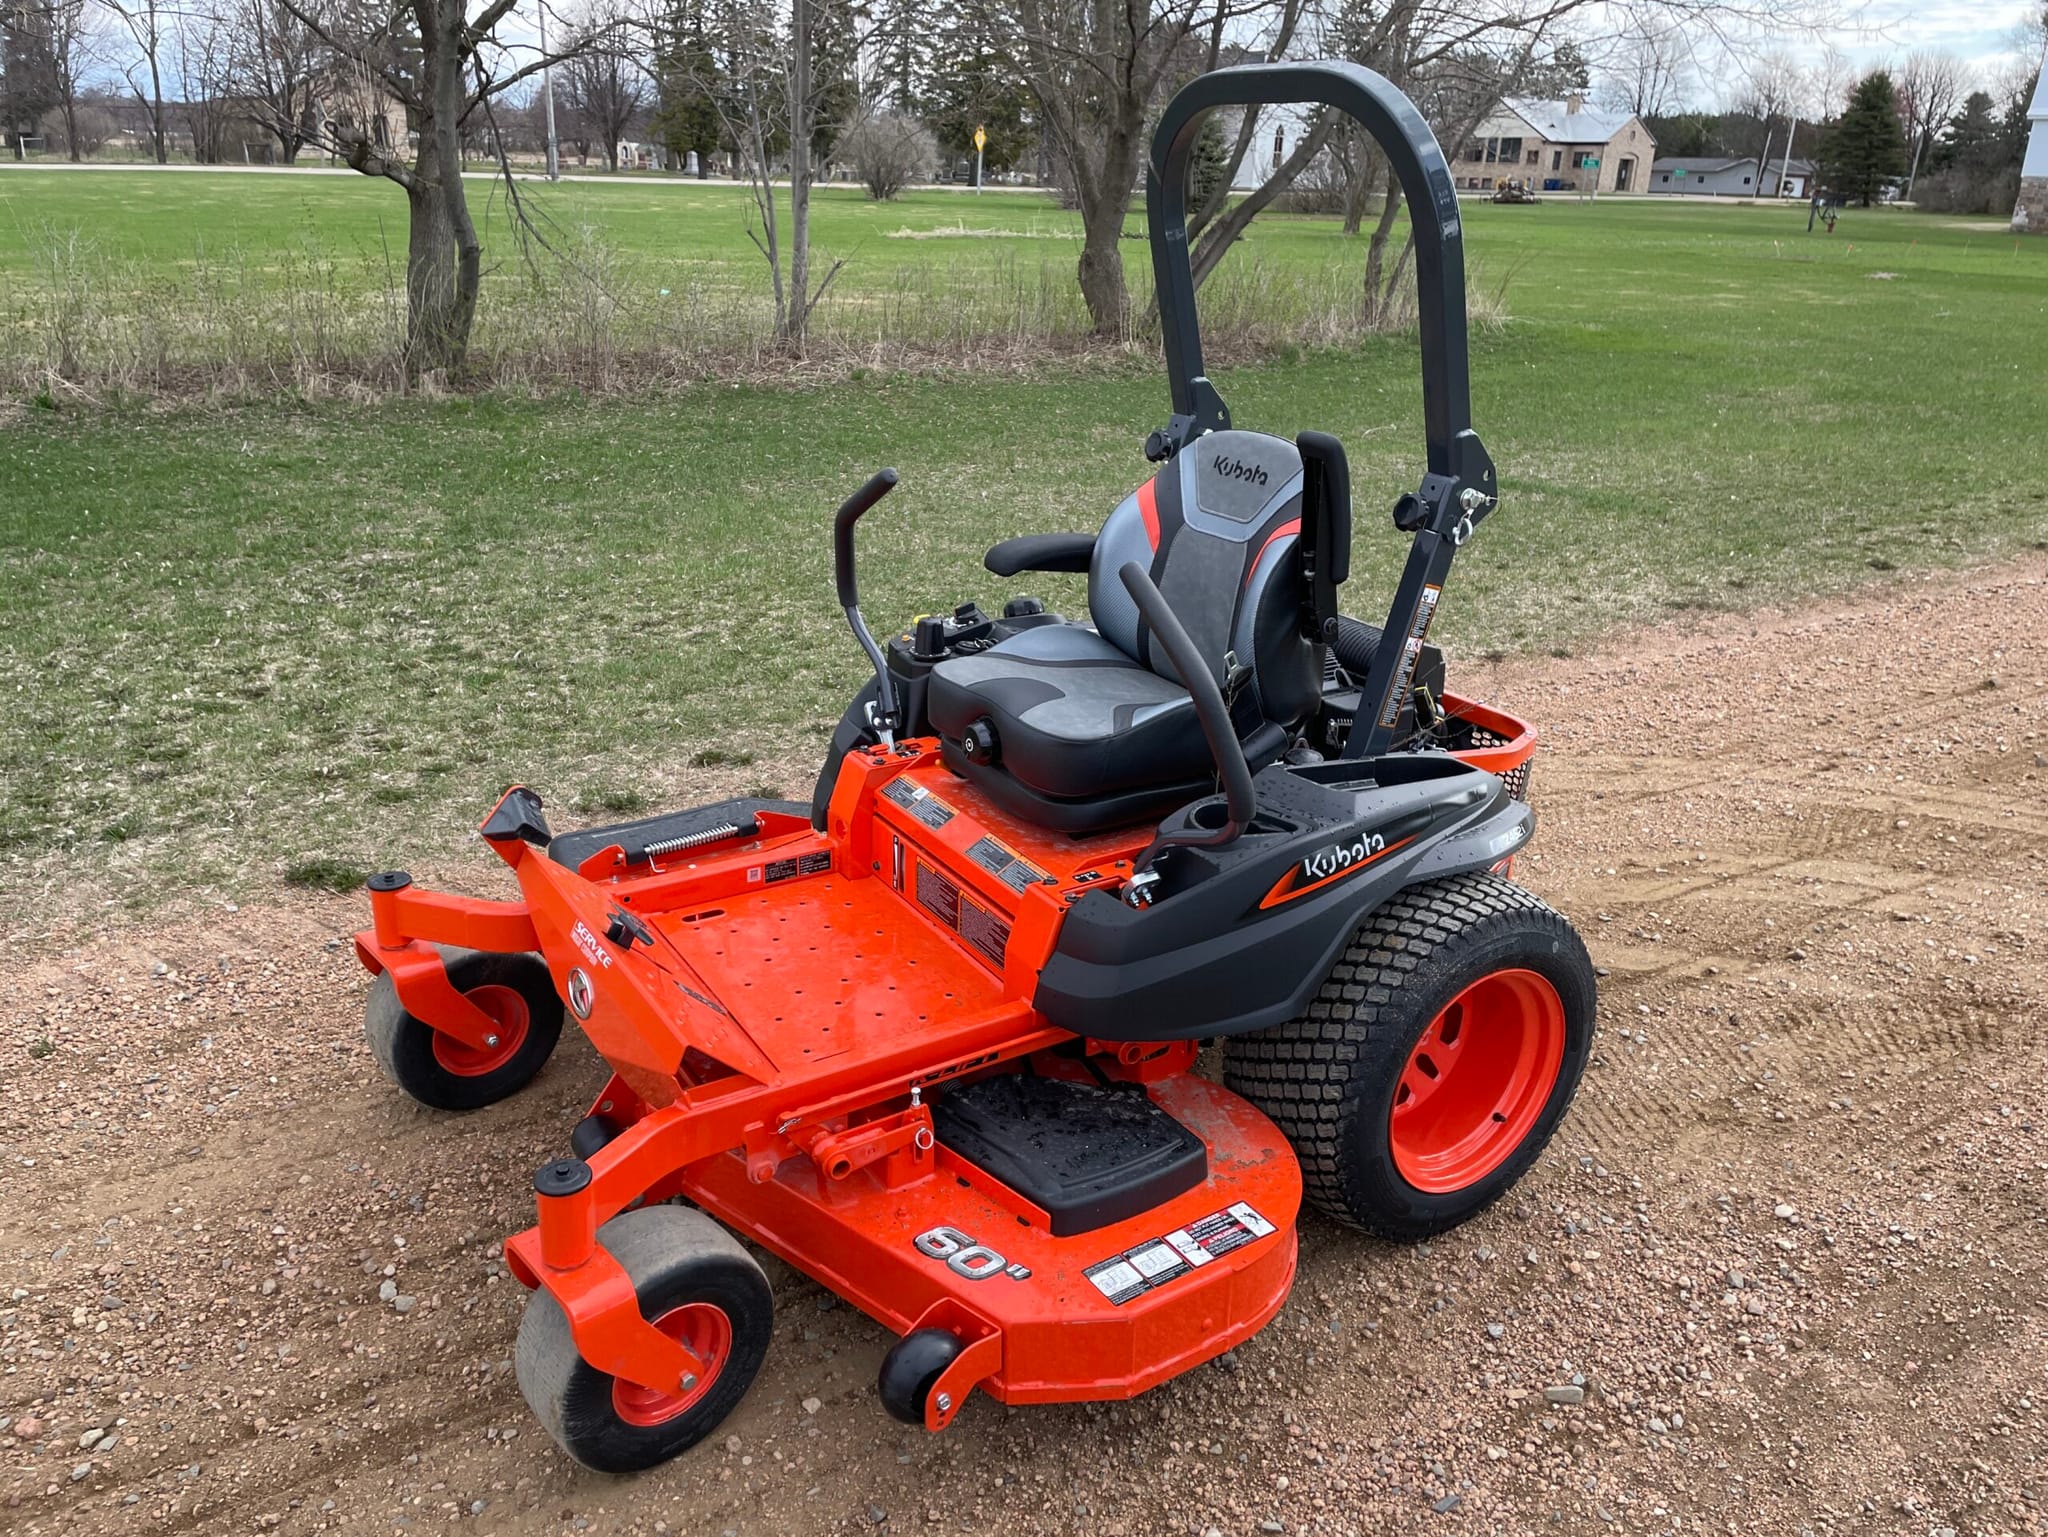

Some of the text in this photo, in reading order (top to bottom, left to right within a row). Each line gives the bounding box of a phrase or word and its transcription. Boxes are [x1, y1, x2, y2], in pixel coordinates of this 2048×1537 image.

[1213, 455, 1269, 486] Kubota
[1304, 832, 1386, 878] Kubota
[574, 921, 613, 969] SERVICE
